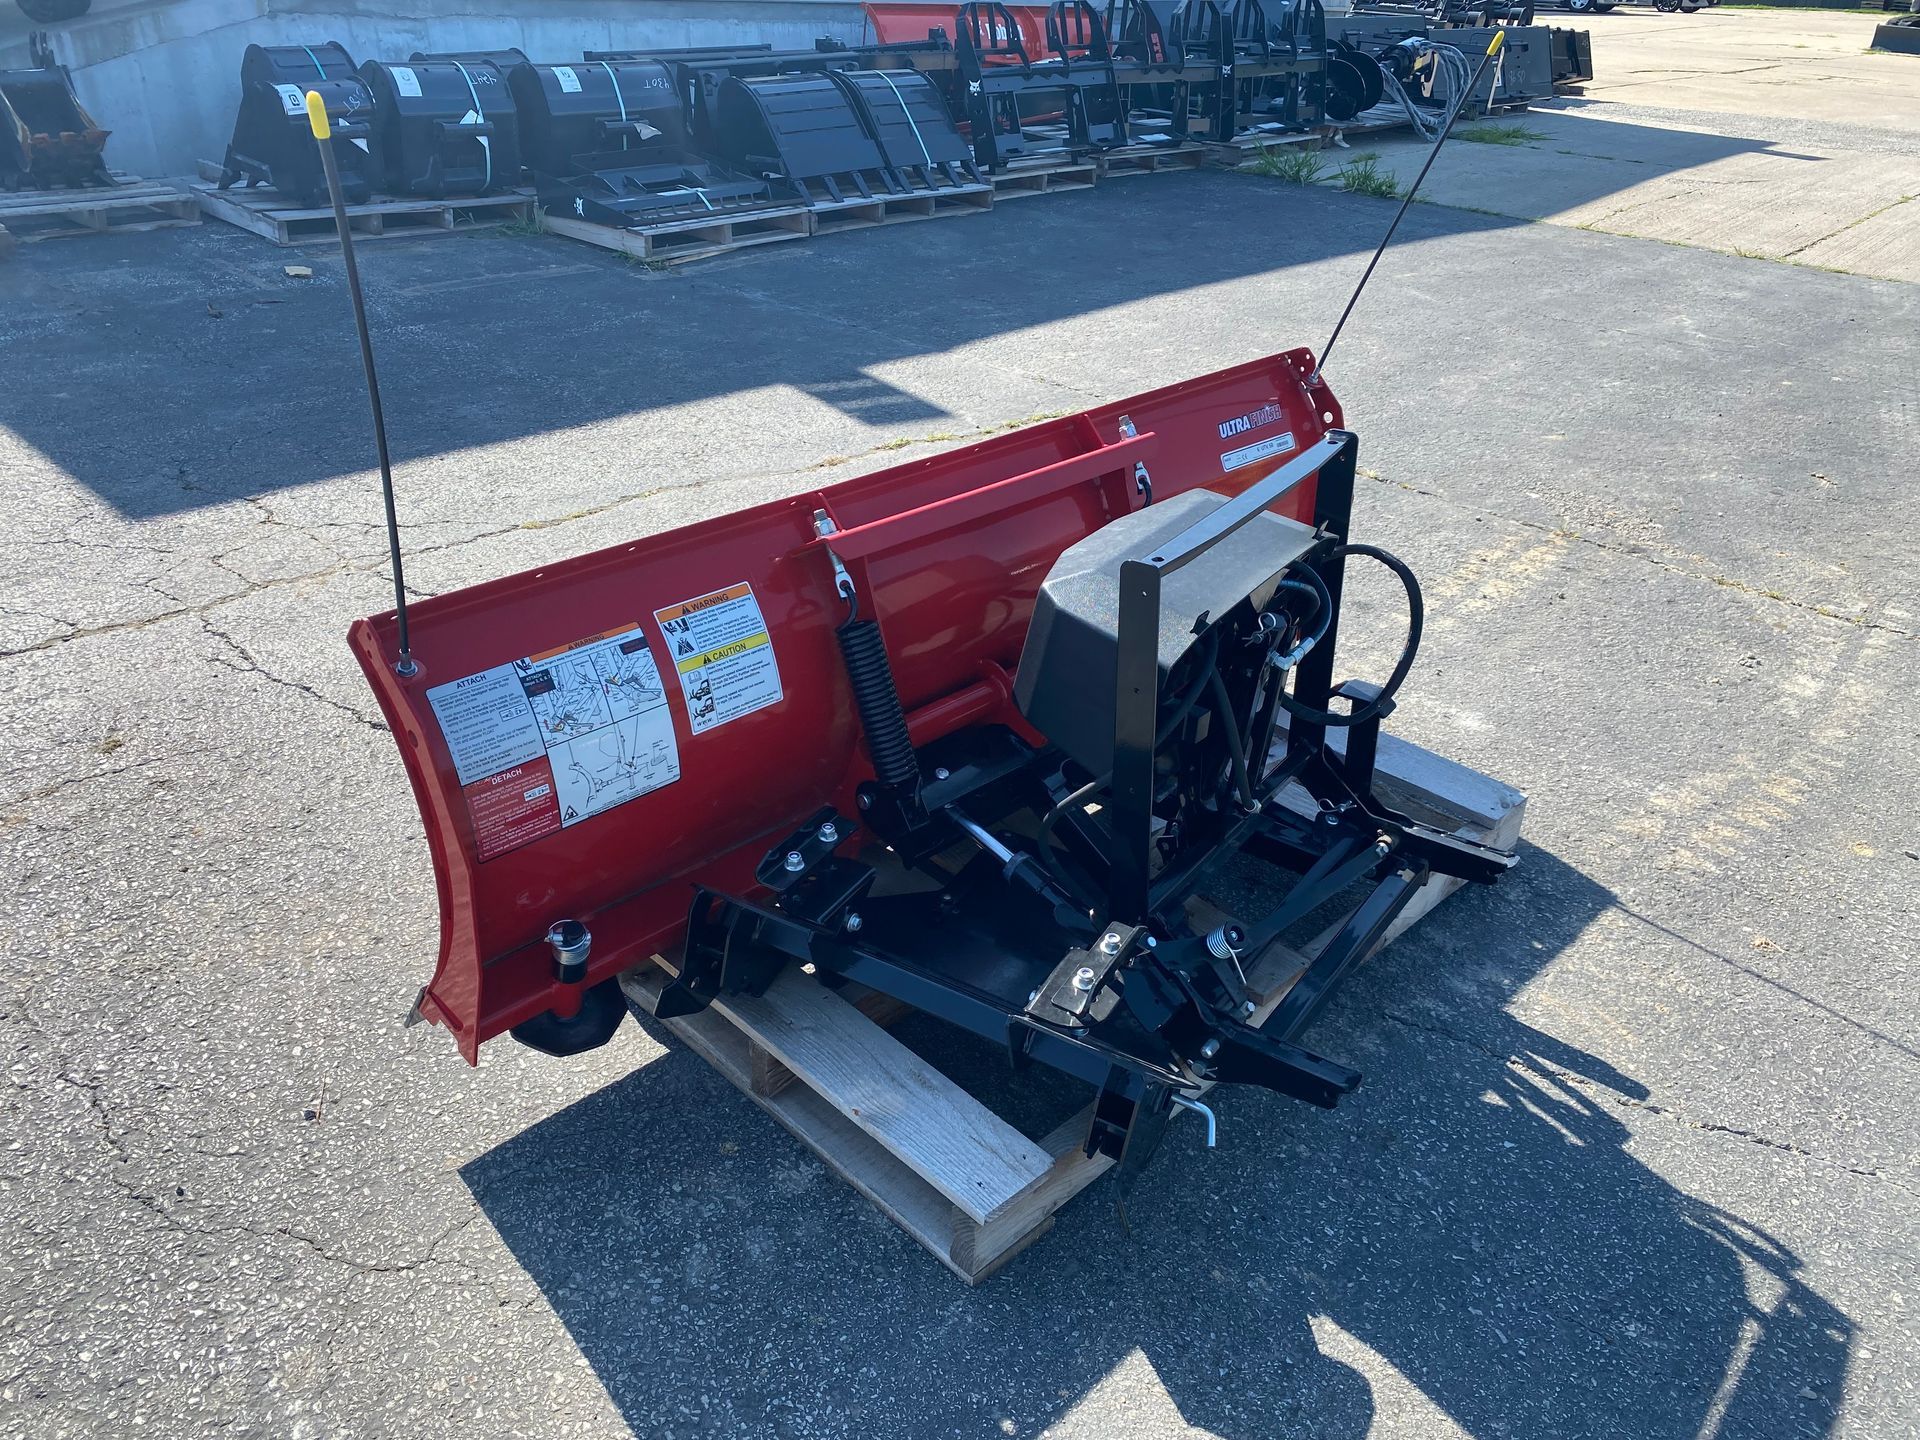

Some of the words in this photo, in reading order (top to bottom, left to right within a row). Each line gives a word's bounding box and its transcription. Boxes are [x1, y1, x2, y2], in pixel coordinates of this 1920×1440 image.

[1219, 415, 1251, 438] ULTRA
[1250, 404, 1281, 428] FINISH
[691, 593, 729, 611] WARNING
[573, 634, 605, 648] WARNING
[712, 643, 747, 660] CAUTION
[456, 674, 487, 689] ATTACH
[491, 768, 522, 785] DETACH
